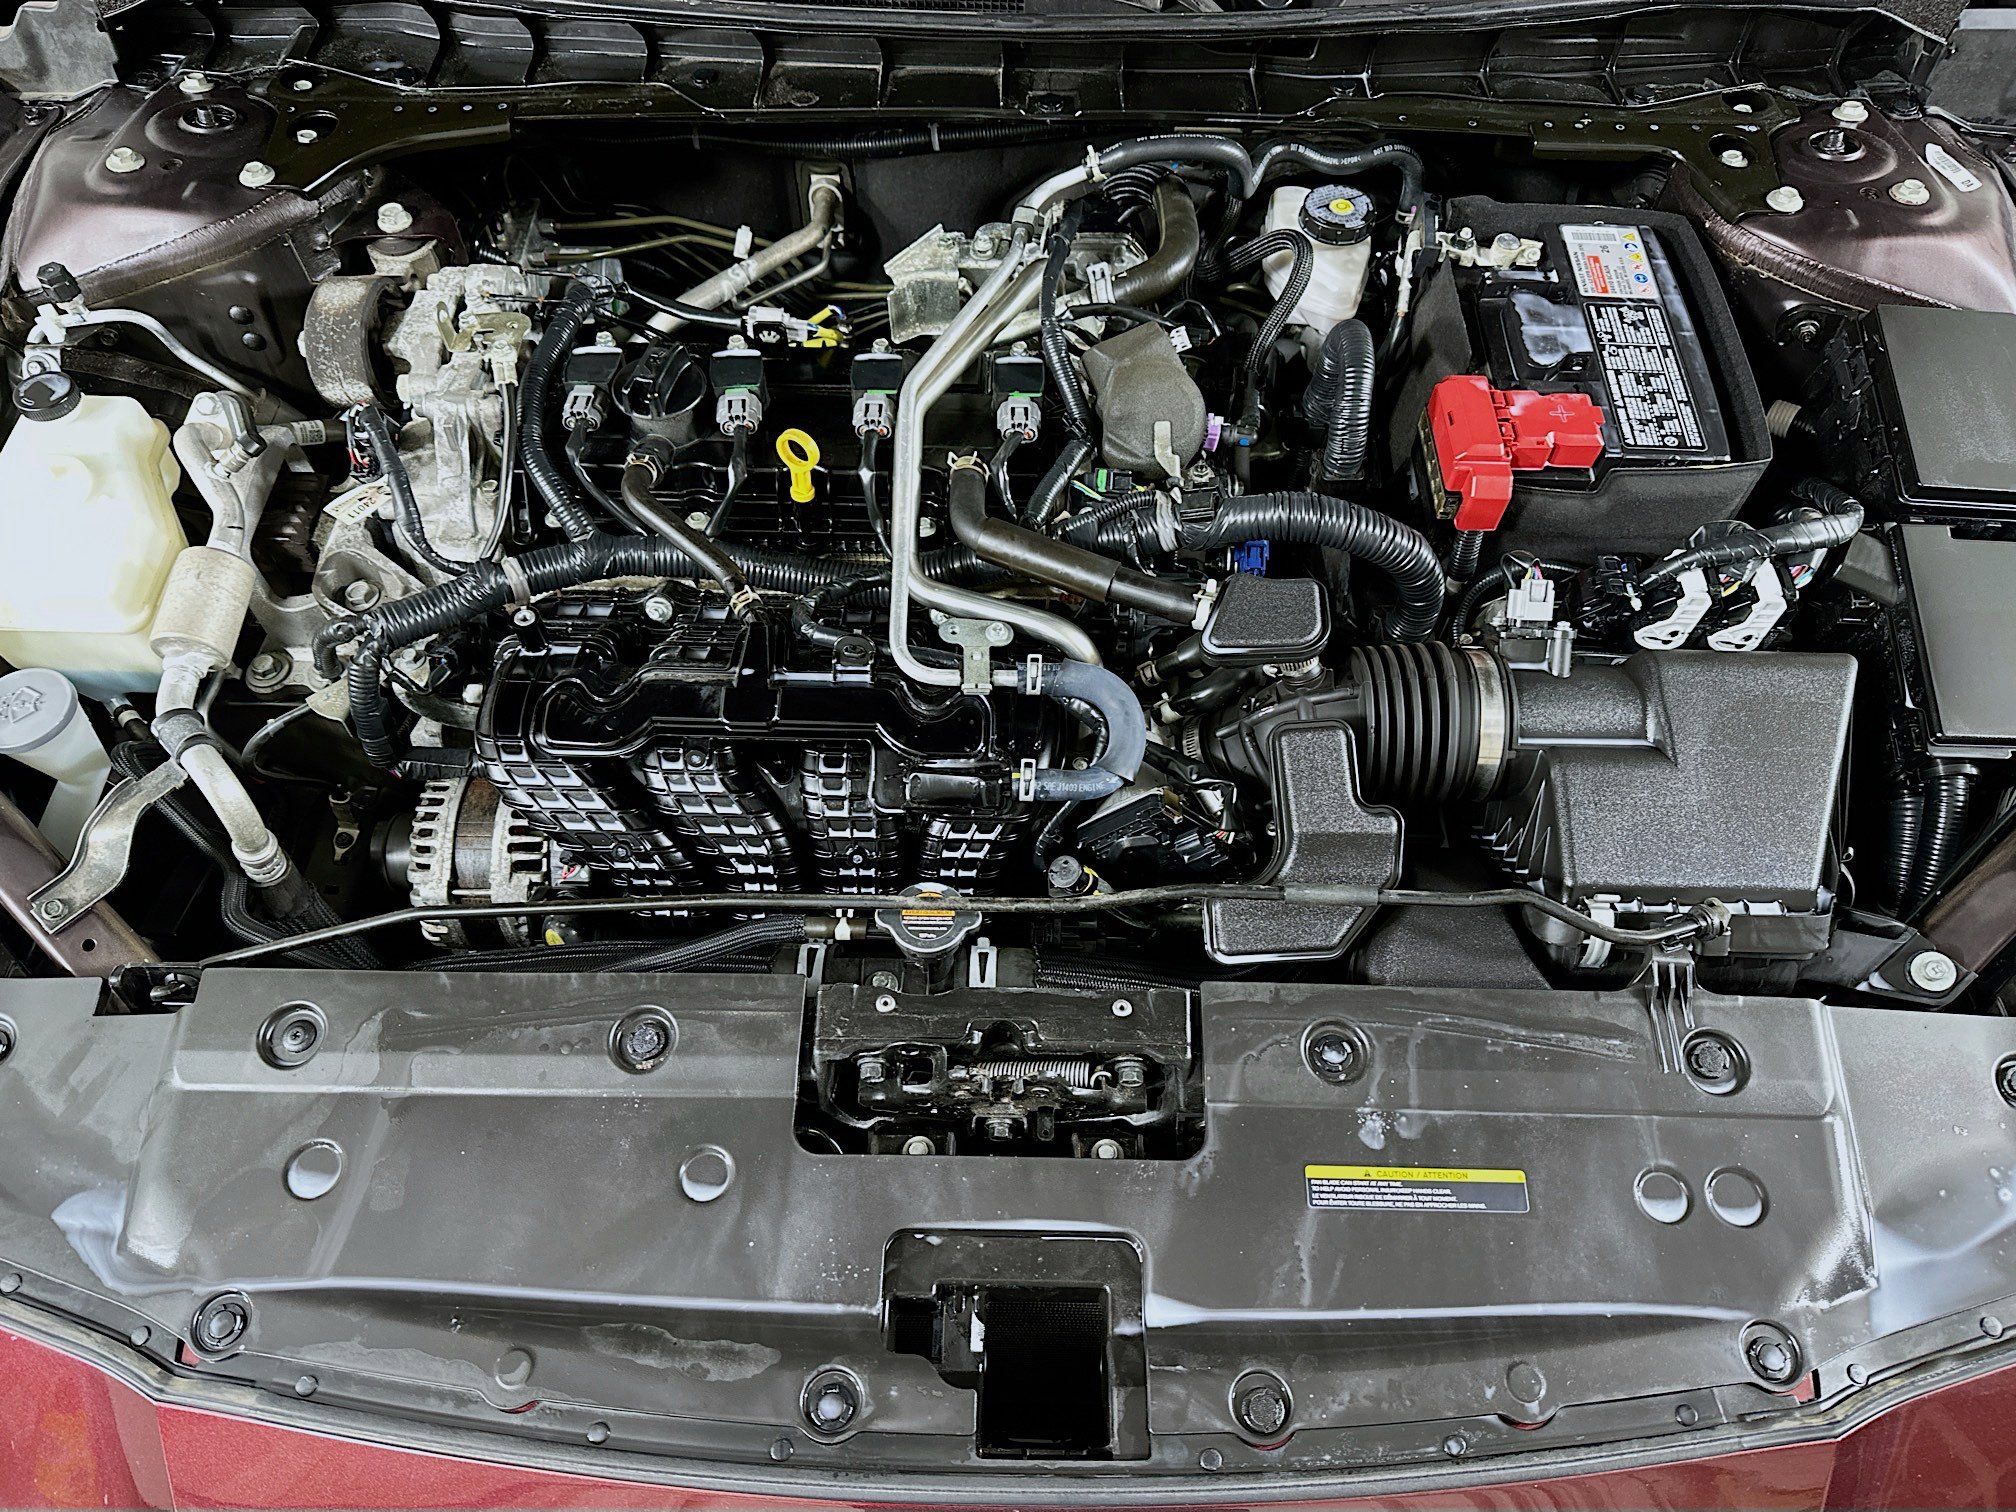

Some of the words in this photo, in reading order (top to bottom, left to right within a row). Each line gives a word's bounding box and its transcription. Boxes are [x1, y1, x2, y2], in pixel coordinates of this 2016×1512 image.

[1600, 244, 1610, 253] 26
[1573, 252, 1582, 272] NISSAN
[348, 497, 376, 518] 24011
[1056, 784, 1077, 792] J1403
[1080, 782, 1106, 792] ENGINE
